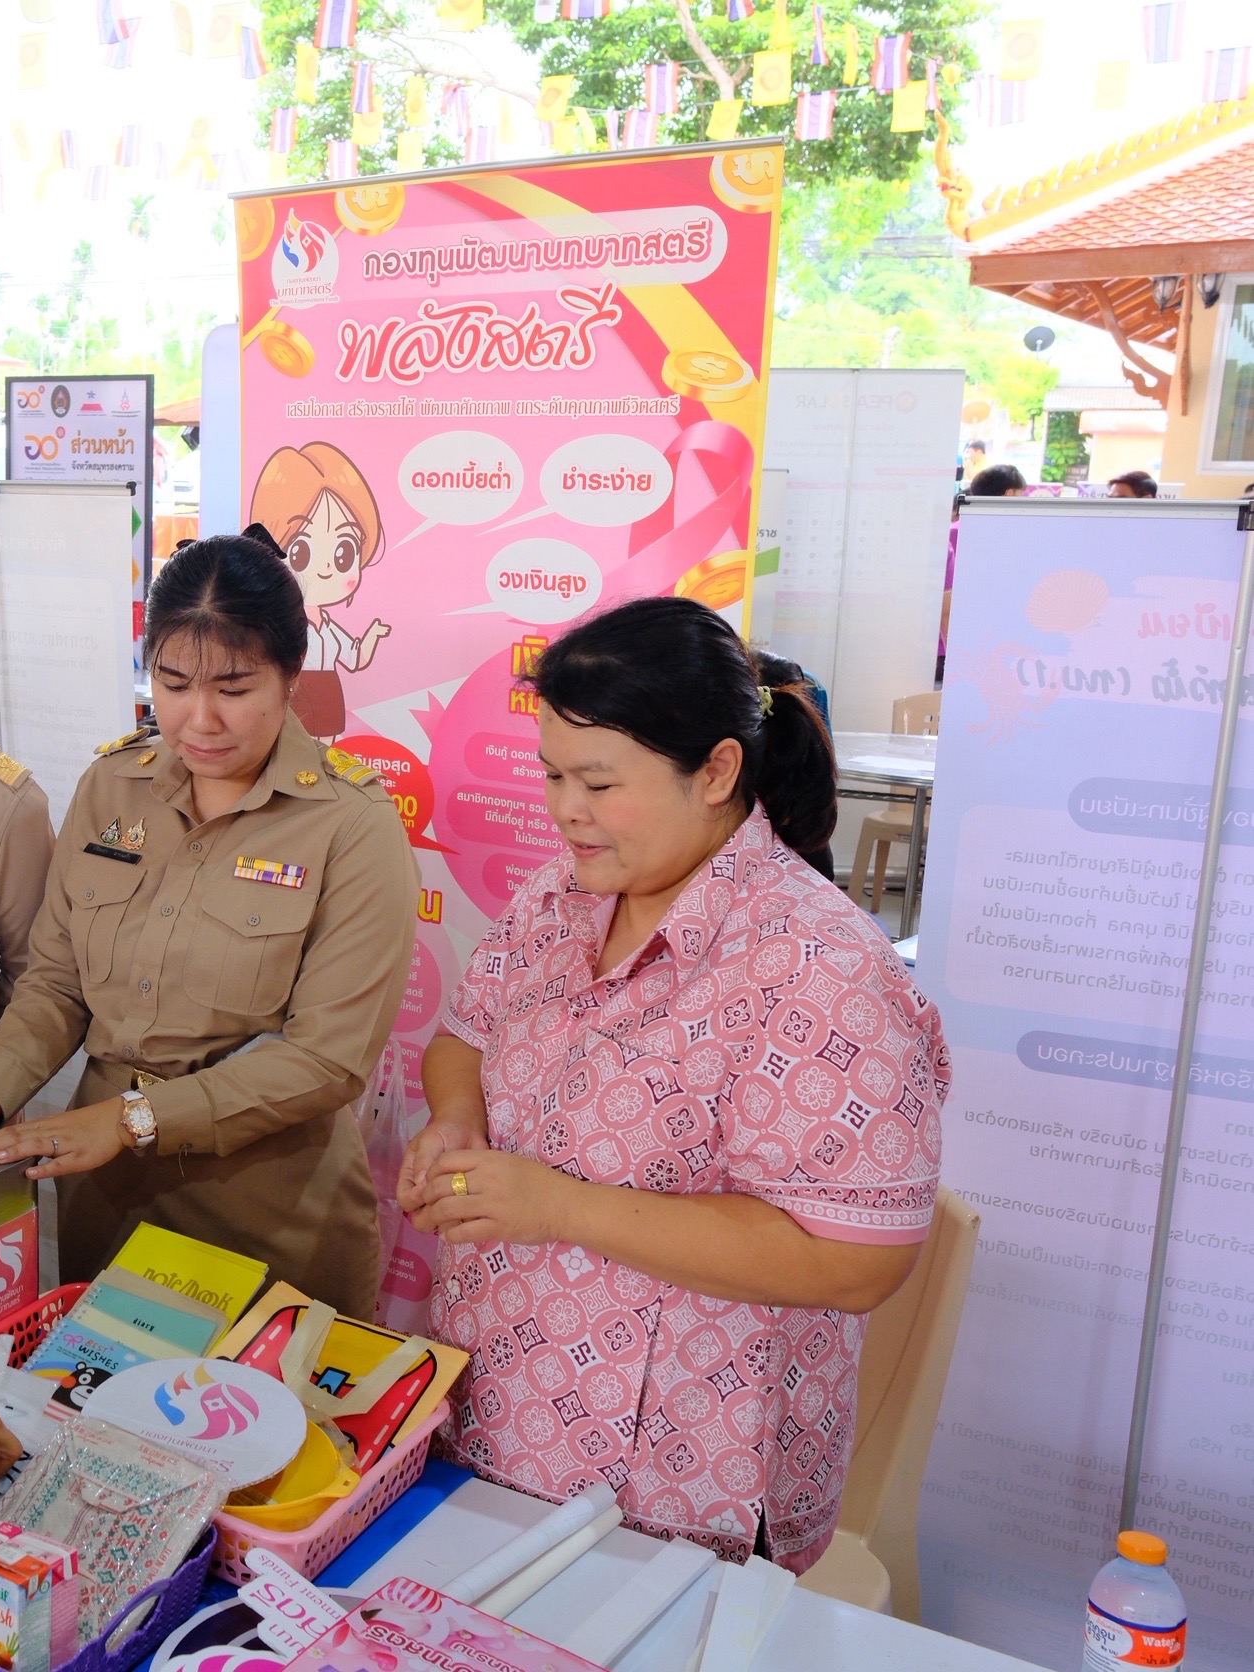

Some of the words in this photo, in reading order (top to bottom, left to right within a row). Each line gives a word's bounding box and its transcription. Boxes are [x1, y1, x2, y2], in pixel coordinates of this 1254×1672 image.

[363, 217, 712, 284] กองทุนพัฒนาบทบาทสตรี
[286, 397, 344, 418] เสริมโอกาส
[348, 396, 414, 417] สร้างรายได้
[419, 396, 511, 417] พัฒนาศักยภาพ
[516, 394, 680, 419] ยกระดับคุณภาพชีวิตสตรี
[70, 428, 135, 455] ส่วนหน้า
[71, 461, 135, 474] จังหวัดสมุทรสงคราม
[410, 460, 513, 491] ดอกเบี้ยต่ำ
[561, 469, 652, 493] ชำระง่าย
[498, 566, 588, 600] วงเงินสูง
[484, 744, 508, 761] เงินกู้
[394, 795, 418, 817] 00
[456, 790, 526, 812] สมาชิกกองทุนฯ
[528, 802, 550, 816] รวม
[484, 811, 524, 831] มีถิ่นที่อยู่
[527, 817, 547, 831] หรือ
[514, 829, 564, 850] ไม่น้อยกว่า
[132, 1316, 156, 1333] diary
[84, 1338, 108, 1353] BEST
[78, 1344, 120, 1371] WISHES
[1141, 1635, 1177, 1648] Water
